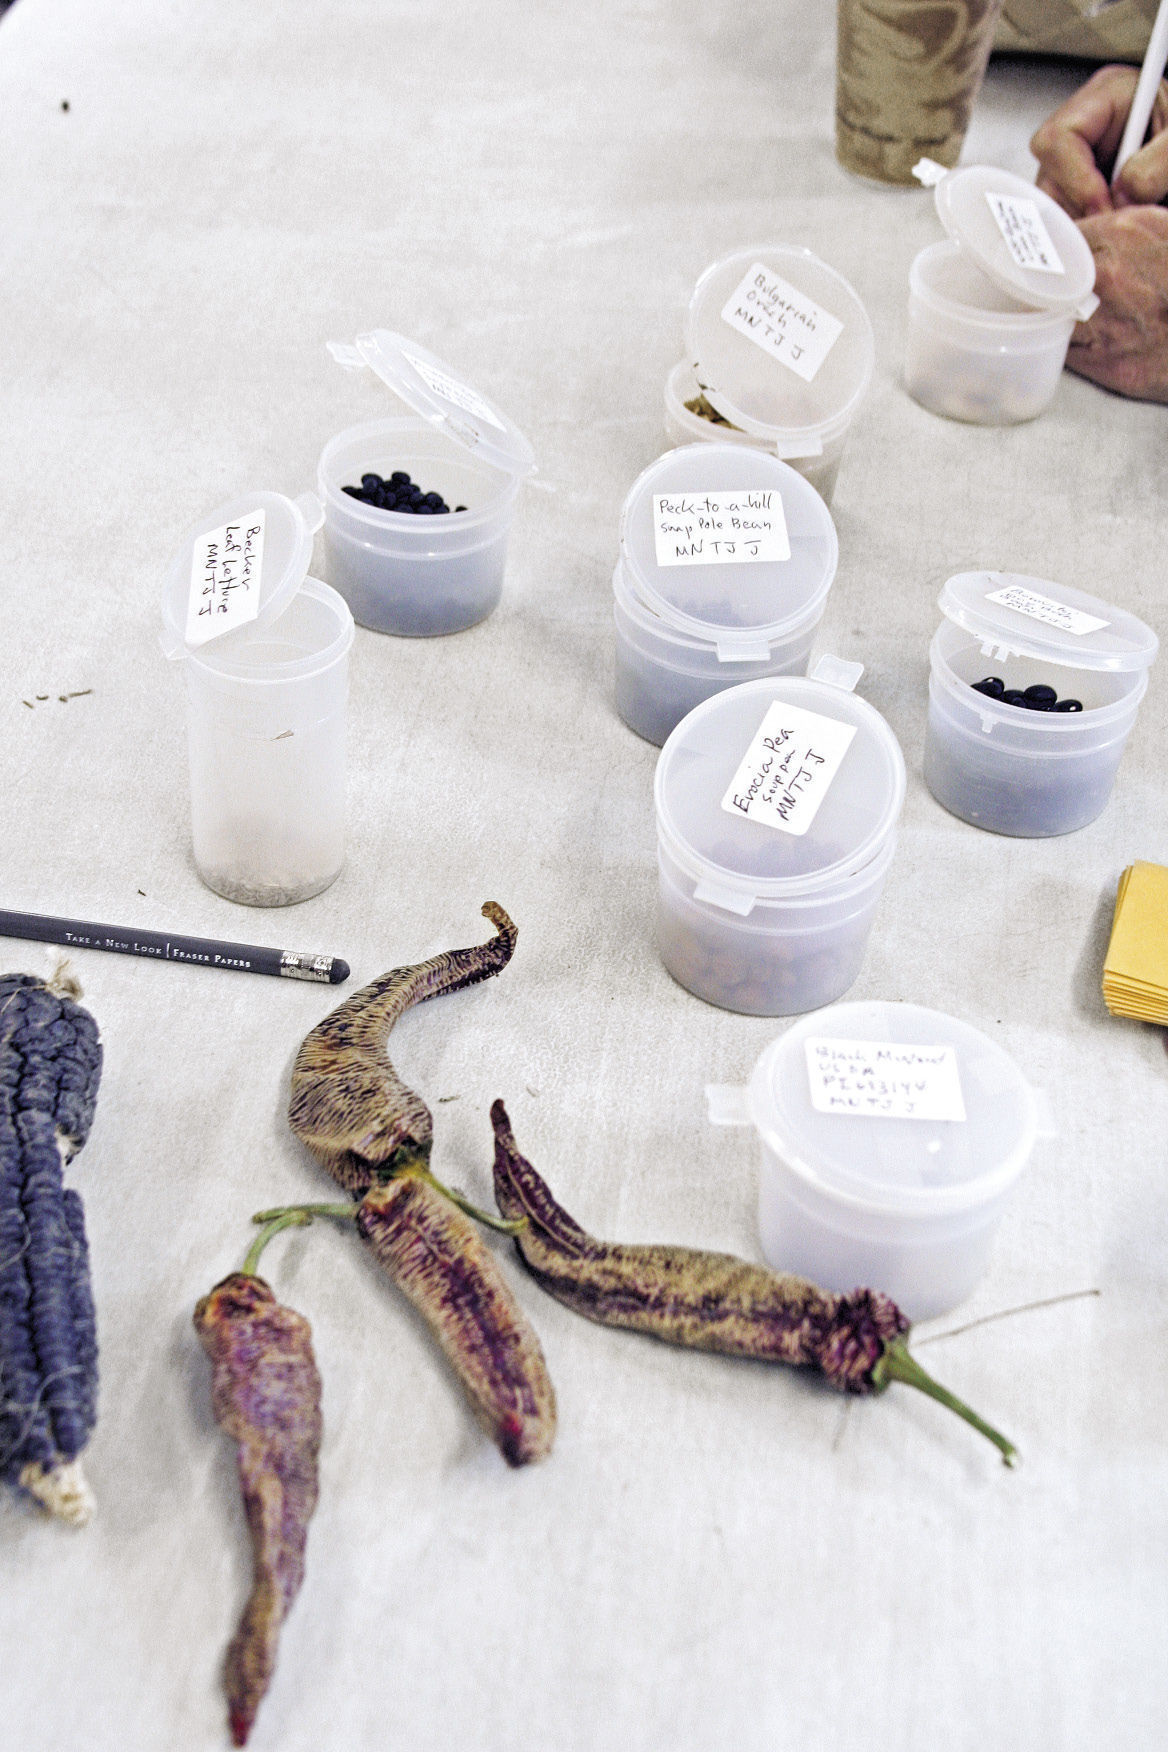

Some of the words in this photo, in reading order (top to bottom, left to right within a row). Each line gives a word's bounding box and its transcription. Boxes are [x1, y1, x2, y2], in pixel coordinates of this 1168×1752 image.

[731, 517, 772, 531] Bean
[224, 526, 242, 553] Leaf
[241, 525, 261, 592] Becker
[762, 728, 795, 754] Pea
